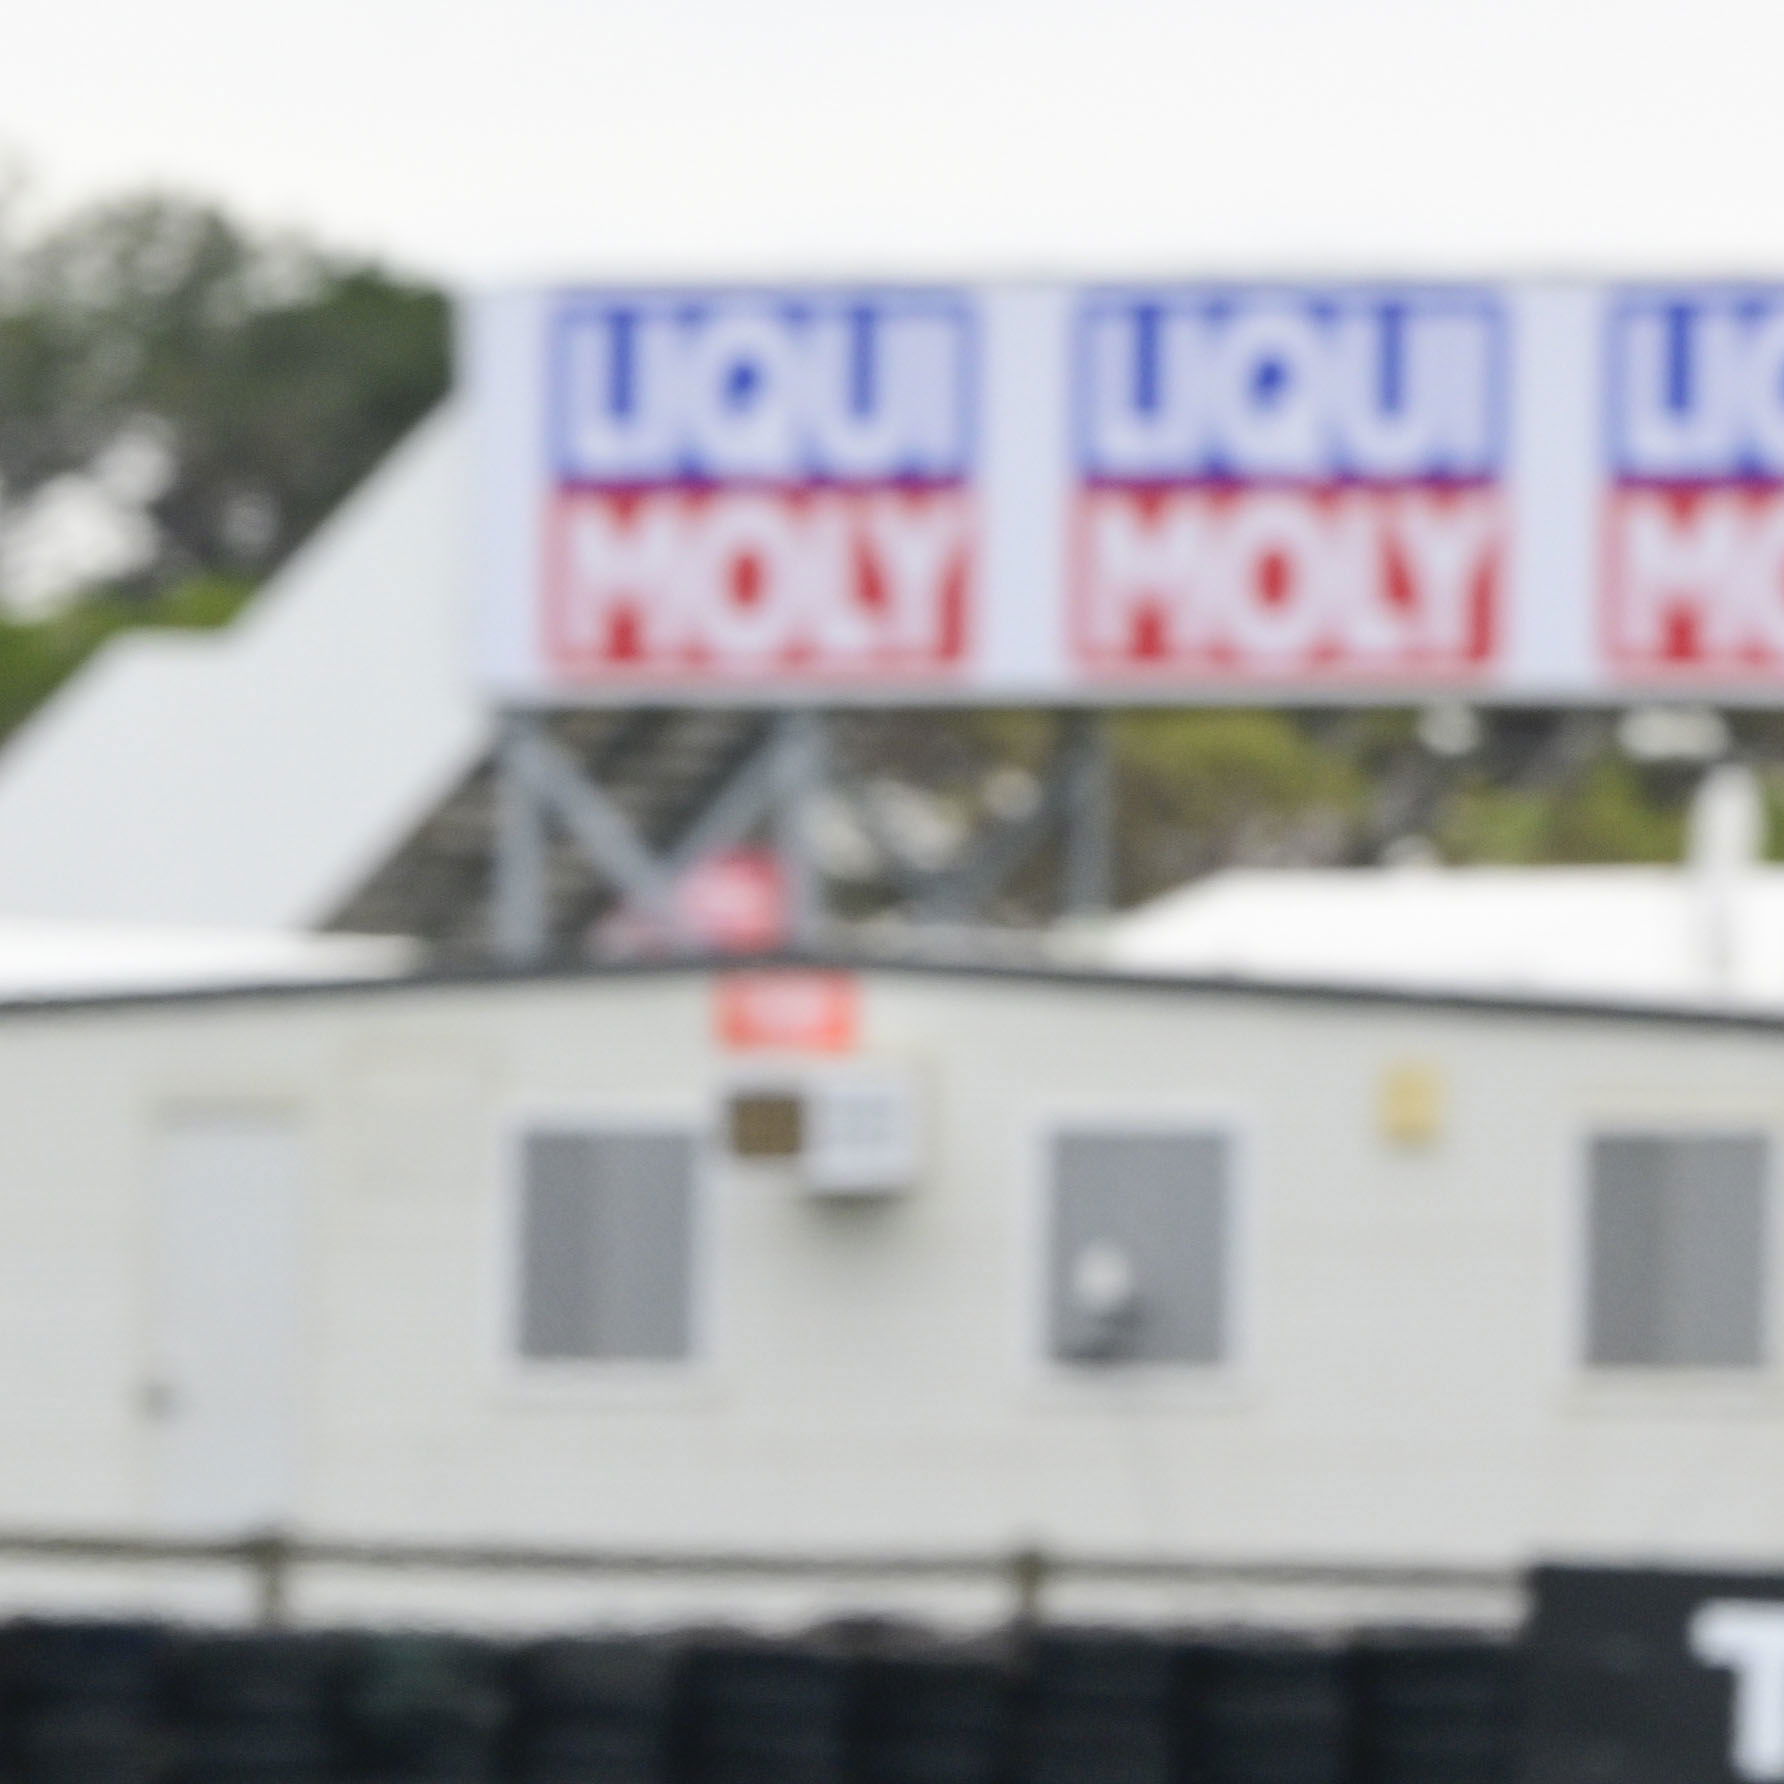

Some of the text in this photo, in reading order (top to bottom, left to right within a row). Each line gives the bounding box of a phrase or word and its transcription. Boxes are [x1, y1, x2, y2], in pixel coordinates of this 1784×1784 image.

[555, 285, 970, 480] LIQUI
[1080, 285, 1500, 480] LIQUI
[545, 488, 970, 680] MOLY
[1070, 488, 1505, 680] MOLY
